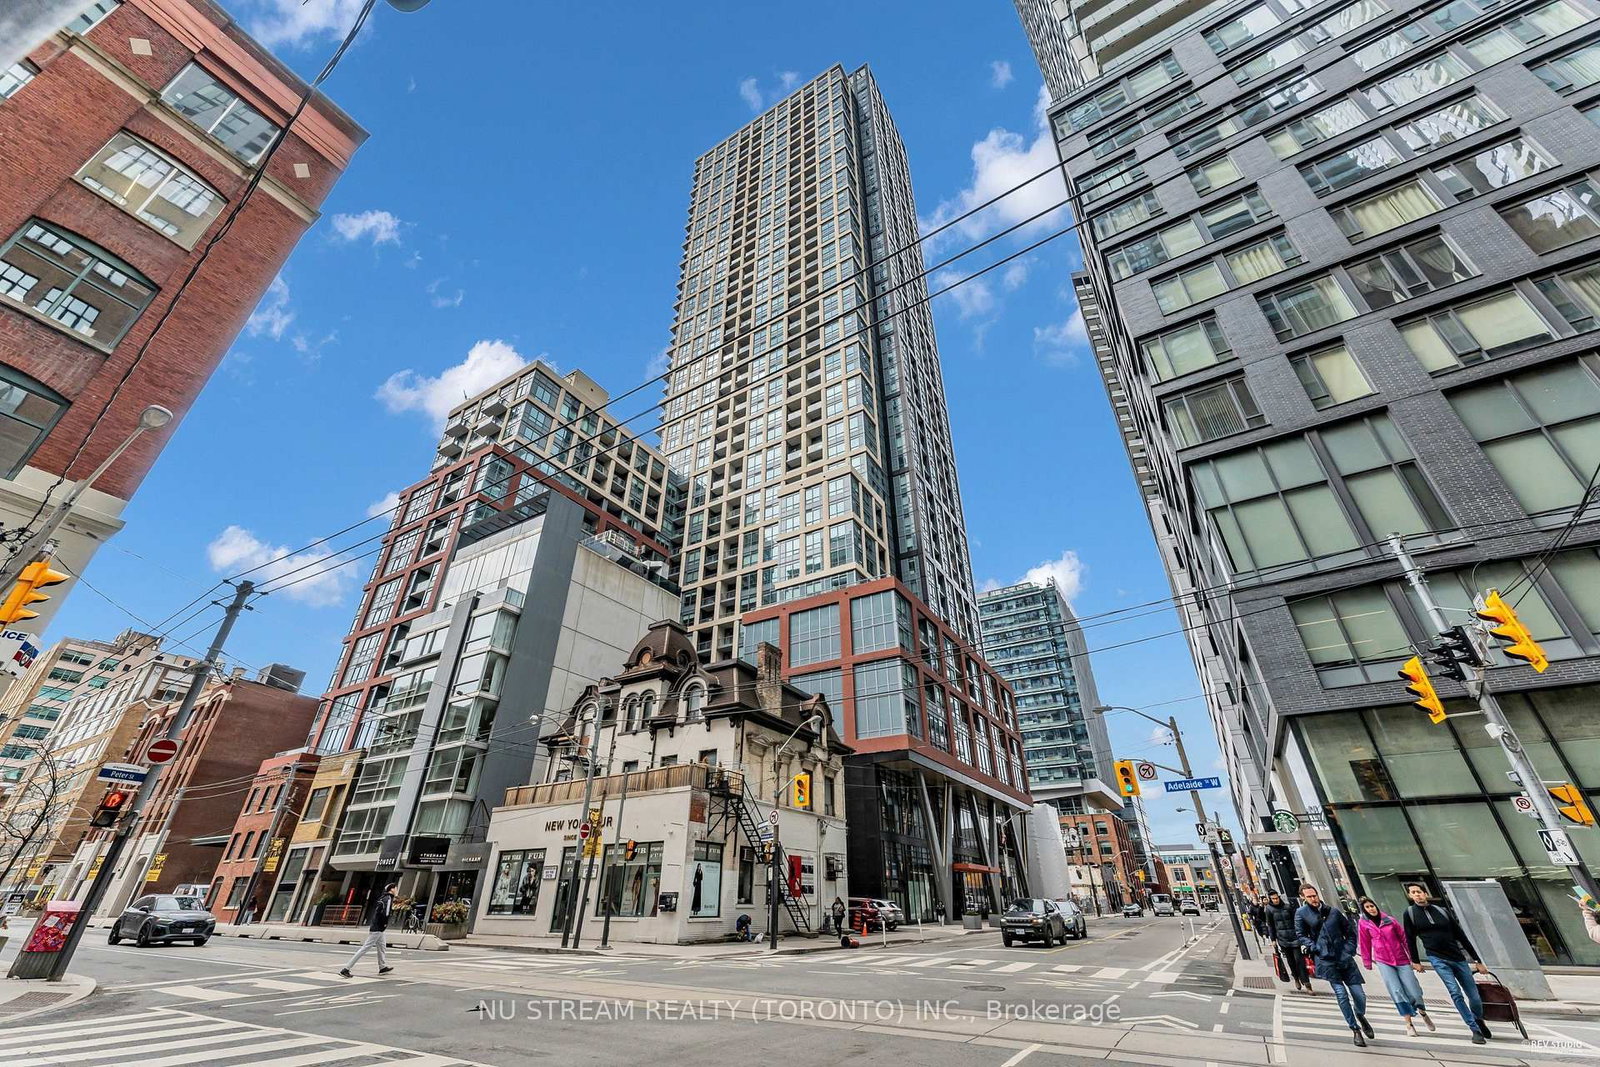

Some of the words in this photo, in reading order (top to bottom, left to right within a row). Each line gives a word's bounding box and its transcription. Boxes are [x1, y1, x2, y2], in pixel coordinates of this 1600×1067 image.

[0, 631, 28, 642] ICE
[110, 770, 129, 779] Peter
[1167, 780, 1203, 791] Adelaide
[1210, 778, 1219, 787] W
[544, 820, 565, 832] NEW
[527, 852, 545, 860] FUR
